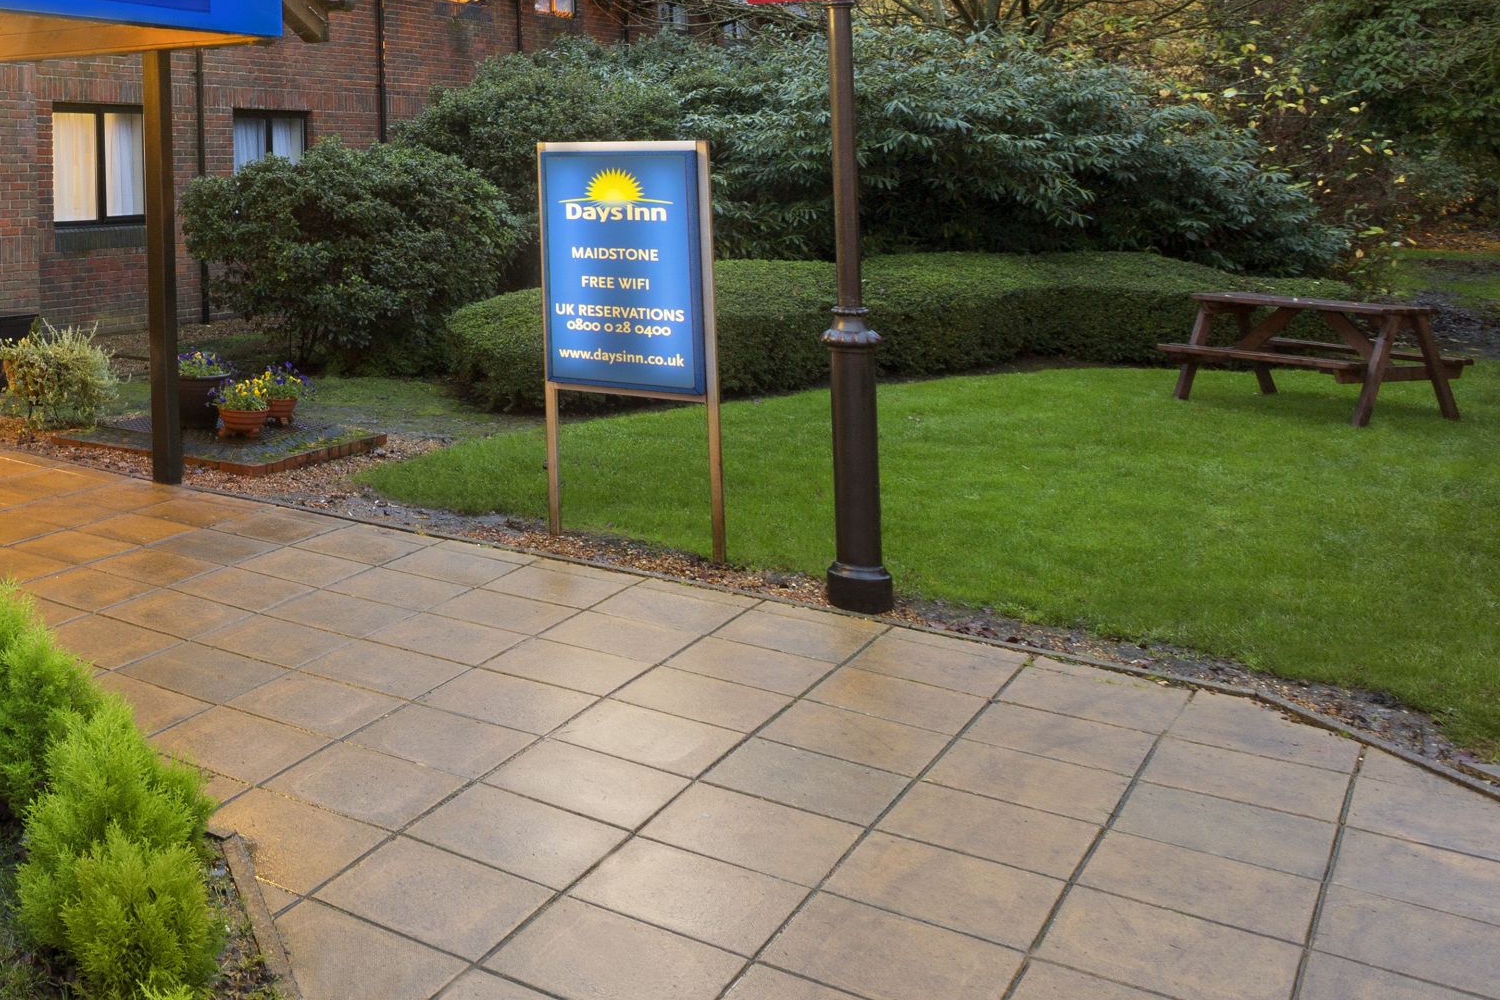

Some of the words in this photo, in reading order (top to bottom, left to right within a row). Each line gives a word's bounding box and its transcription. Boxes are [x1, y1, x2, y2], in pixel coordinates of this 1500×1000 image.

[565, 203, 623, 223] Days
[627, 205, 667, 222] Inn
[571, 246, 659, 261] MAIDSTONE
[581, 275, 615, 289] FREE
[618, 277, 650, 290] WIFI
[555, 303, 575, 316] UK
[578, 304, 684, 322] RESERVATIONS
[567, 318, 601, 332] 0800
[635, 324, 671, 337] 0400
[559, 347, 684, 368] www.daysinn.co.uk
